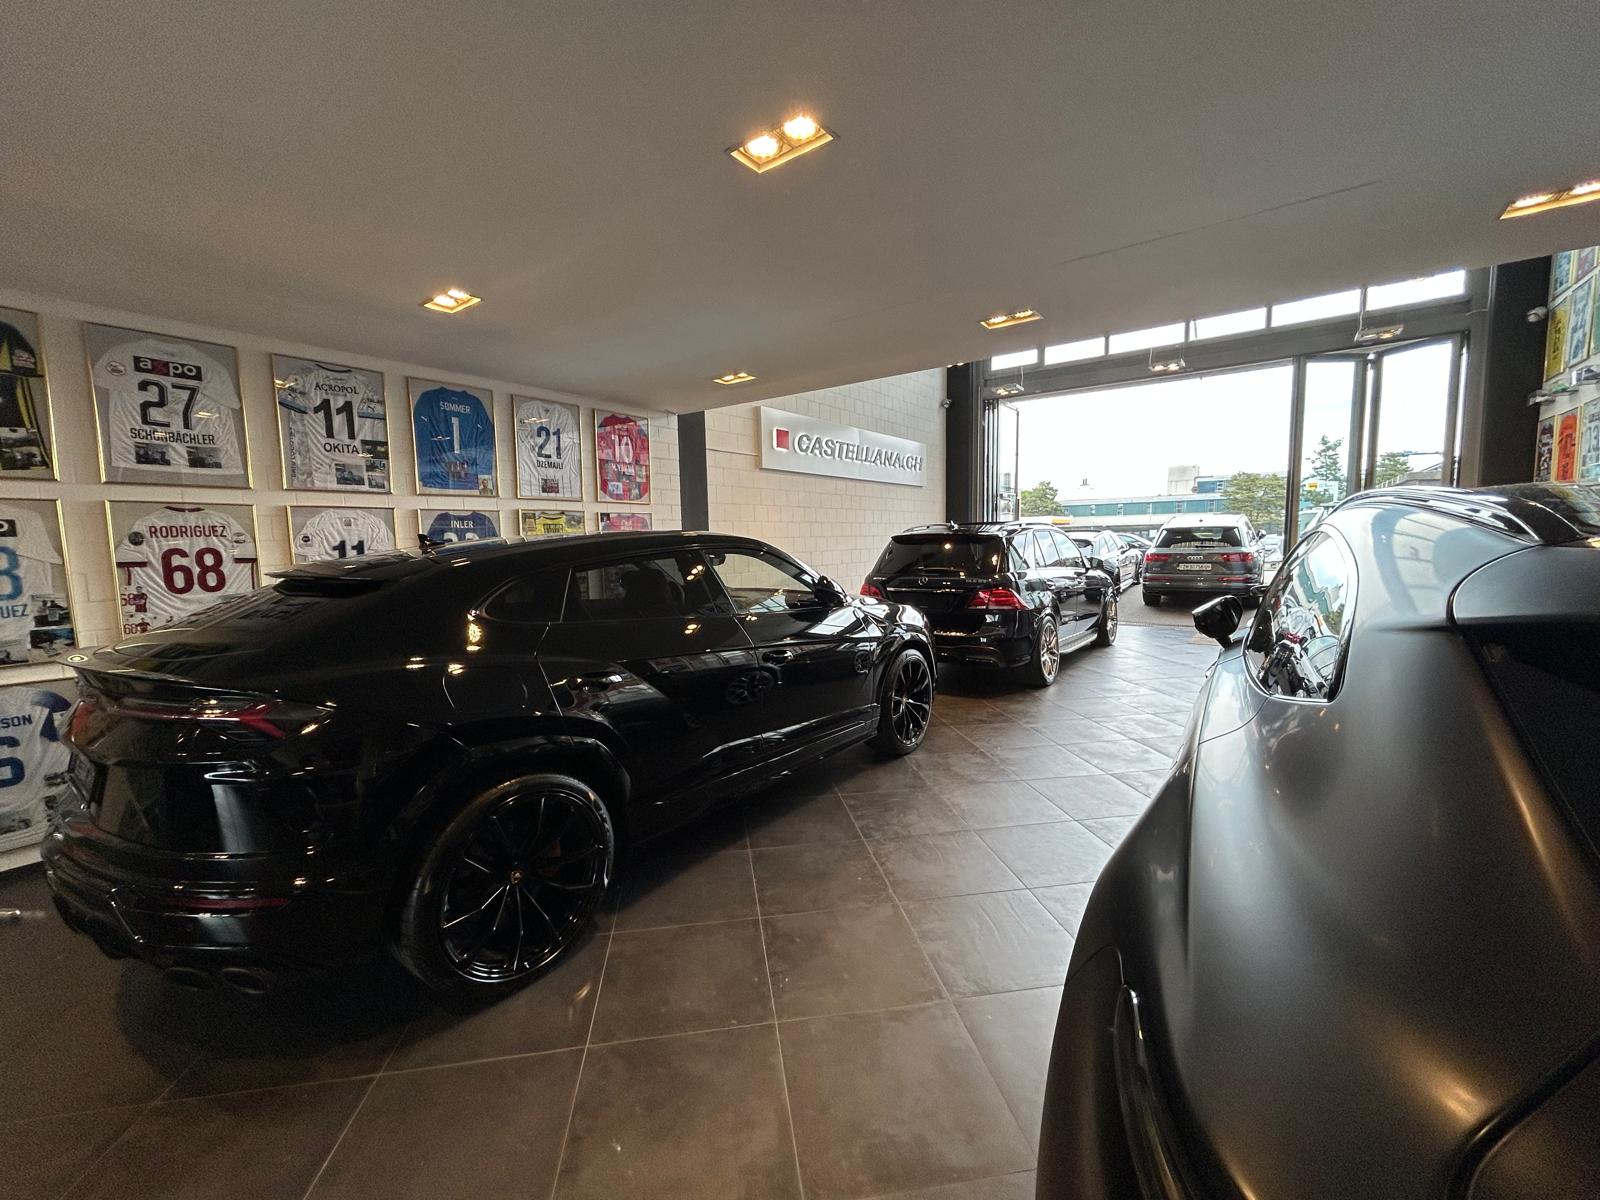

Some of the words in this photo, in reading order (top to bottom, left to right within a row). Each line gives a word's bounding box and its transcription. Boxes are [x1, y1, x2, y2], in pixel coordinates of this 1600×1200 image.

[314, 382, 360, 395] ACROPOL
[138, 378, 200, 430] 27
[440, 401, 471, 414] SOMMER
[313, 398, 356, 440] 11
[451, 416, 460, 454] 1
[536, 425, 562, 460] 21
[323, 442, 360, 455] OKITA
[148, 525, 228, 539] RODRIGUEZ
[450, 520, 474, 529] INLER
[161, 547, 227, 595] 68
